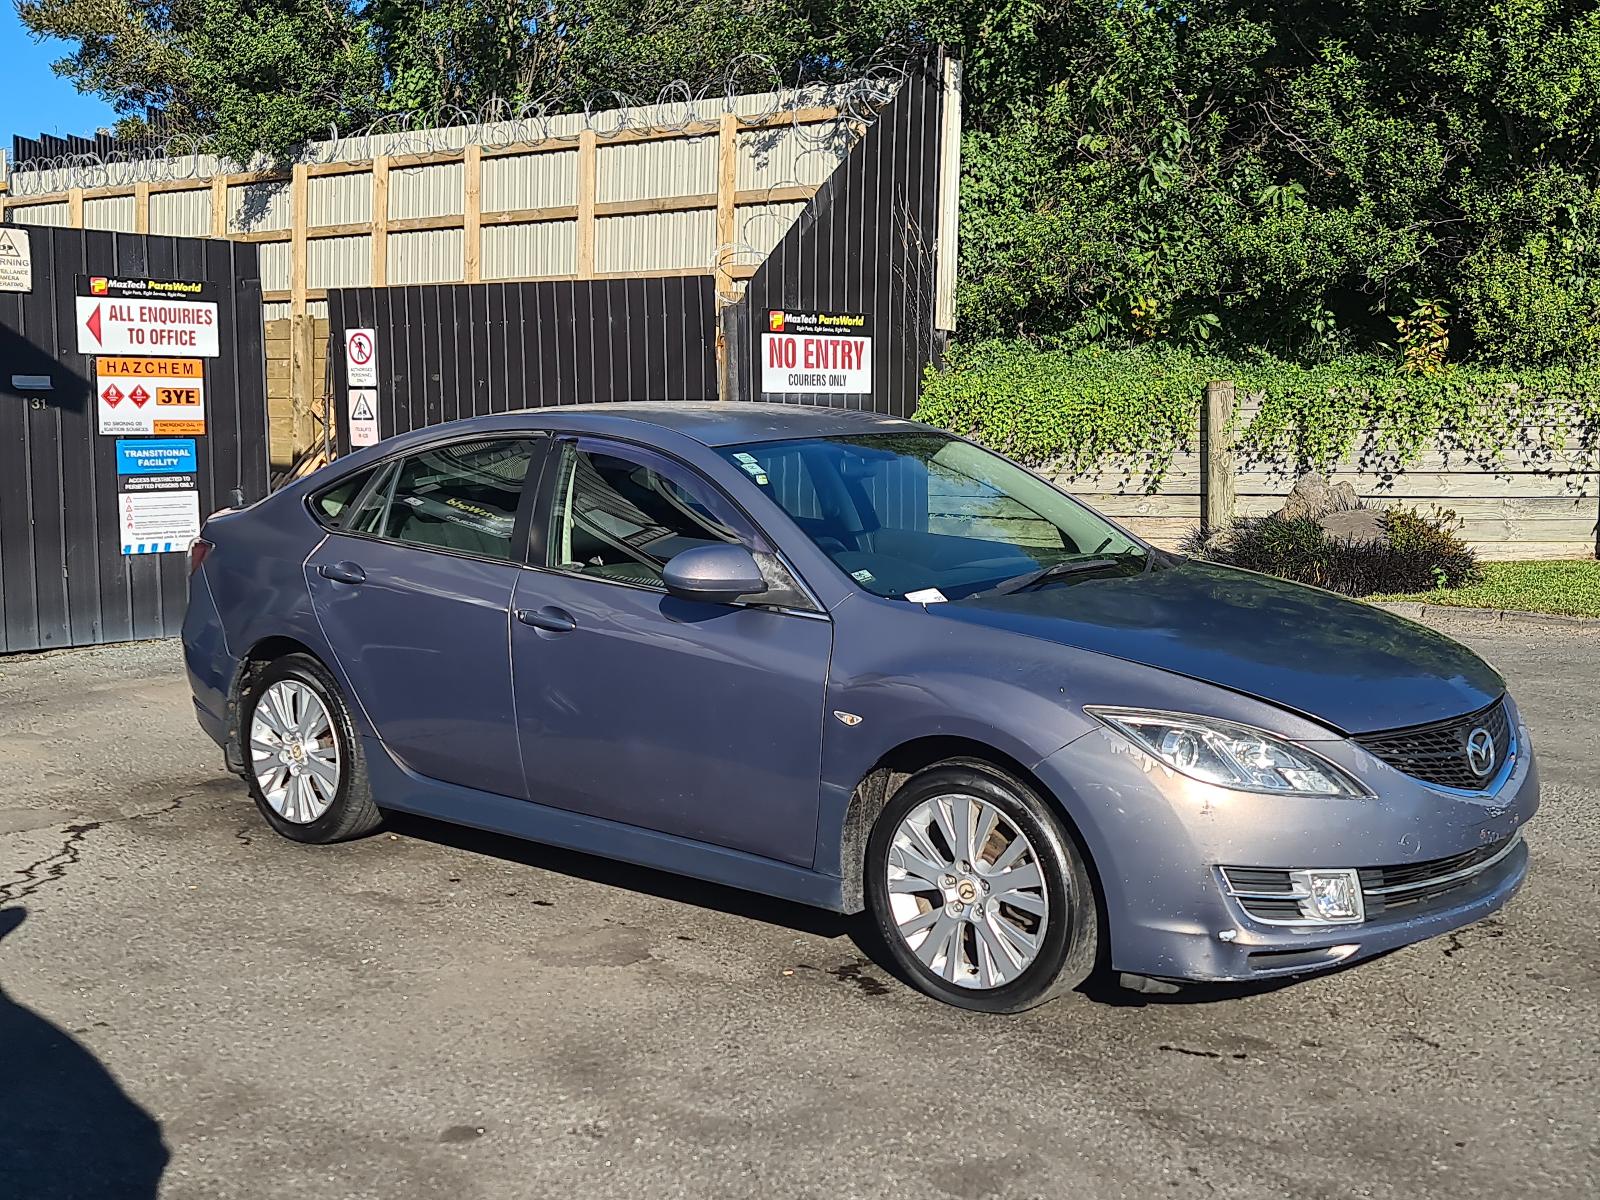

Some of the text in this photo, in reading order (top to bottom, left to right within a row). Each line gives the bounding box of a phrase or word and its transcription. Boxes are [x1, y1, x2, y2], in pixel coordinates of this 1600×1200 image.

[0, 258, 29, 267] RNING
[108, 280, 201, 293] MaxTech PartsWorld
[109, 304, 213, 325] ALL ENQUIRIES
[784, 313, 865, 326] MaxTech PartsWorld
[127, 328, 197, 346] TO OFFICE
[769, 337, 865, 371] NO ENTRY
[106, 361, 194, 375] HAZCHEM
[788, 373, 847, 387] COURIERS ONLY
[161, 389, 196, 404] 3YE
[31, 397, 46, 410] 31
[124, 449, 191, 458] TRANSITIONAL
[137, 458, 179, 467] FACILITY
